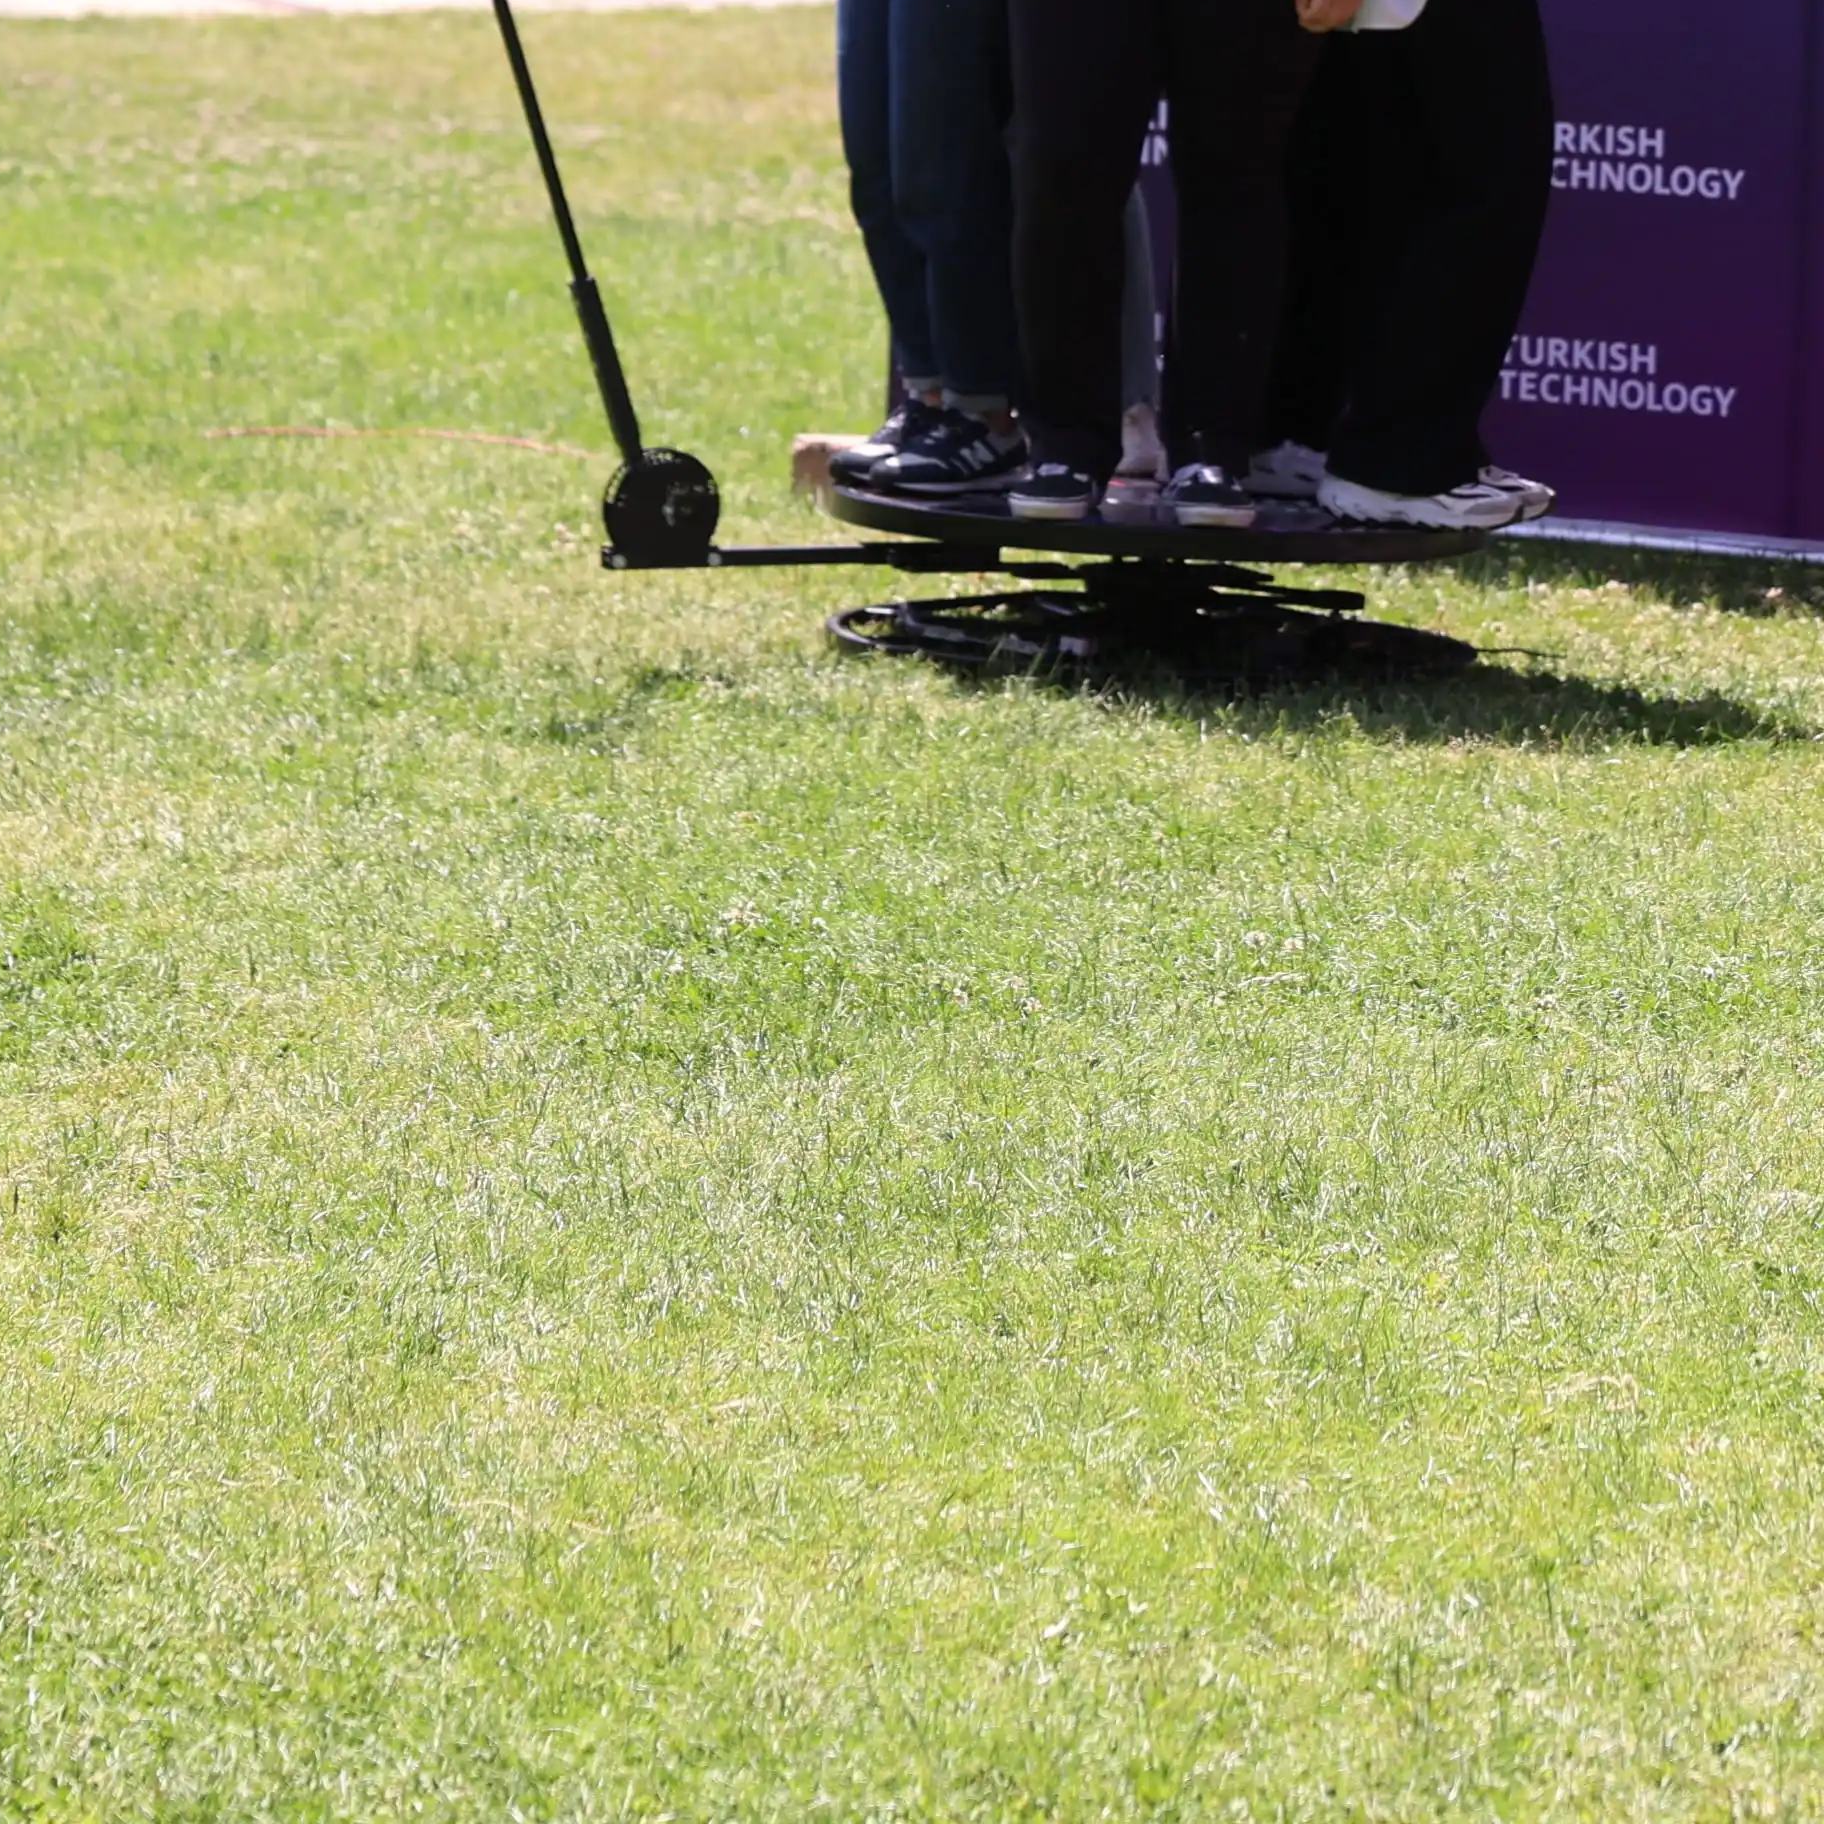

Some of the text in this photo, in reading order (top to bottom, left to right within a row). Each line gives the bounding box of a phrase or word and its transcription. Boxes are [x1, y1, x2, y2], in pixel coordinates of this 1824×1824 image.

[1554, 121, 1664, 158] RKISH
[1550, 157, 1744, 199] CHNOLOGY
[1499, 370, 1736, 417] TECHNOLOGY
